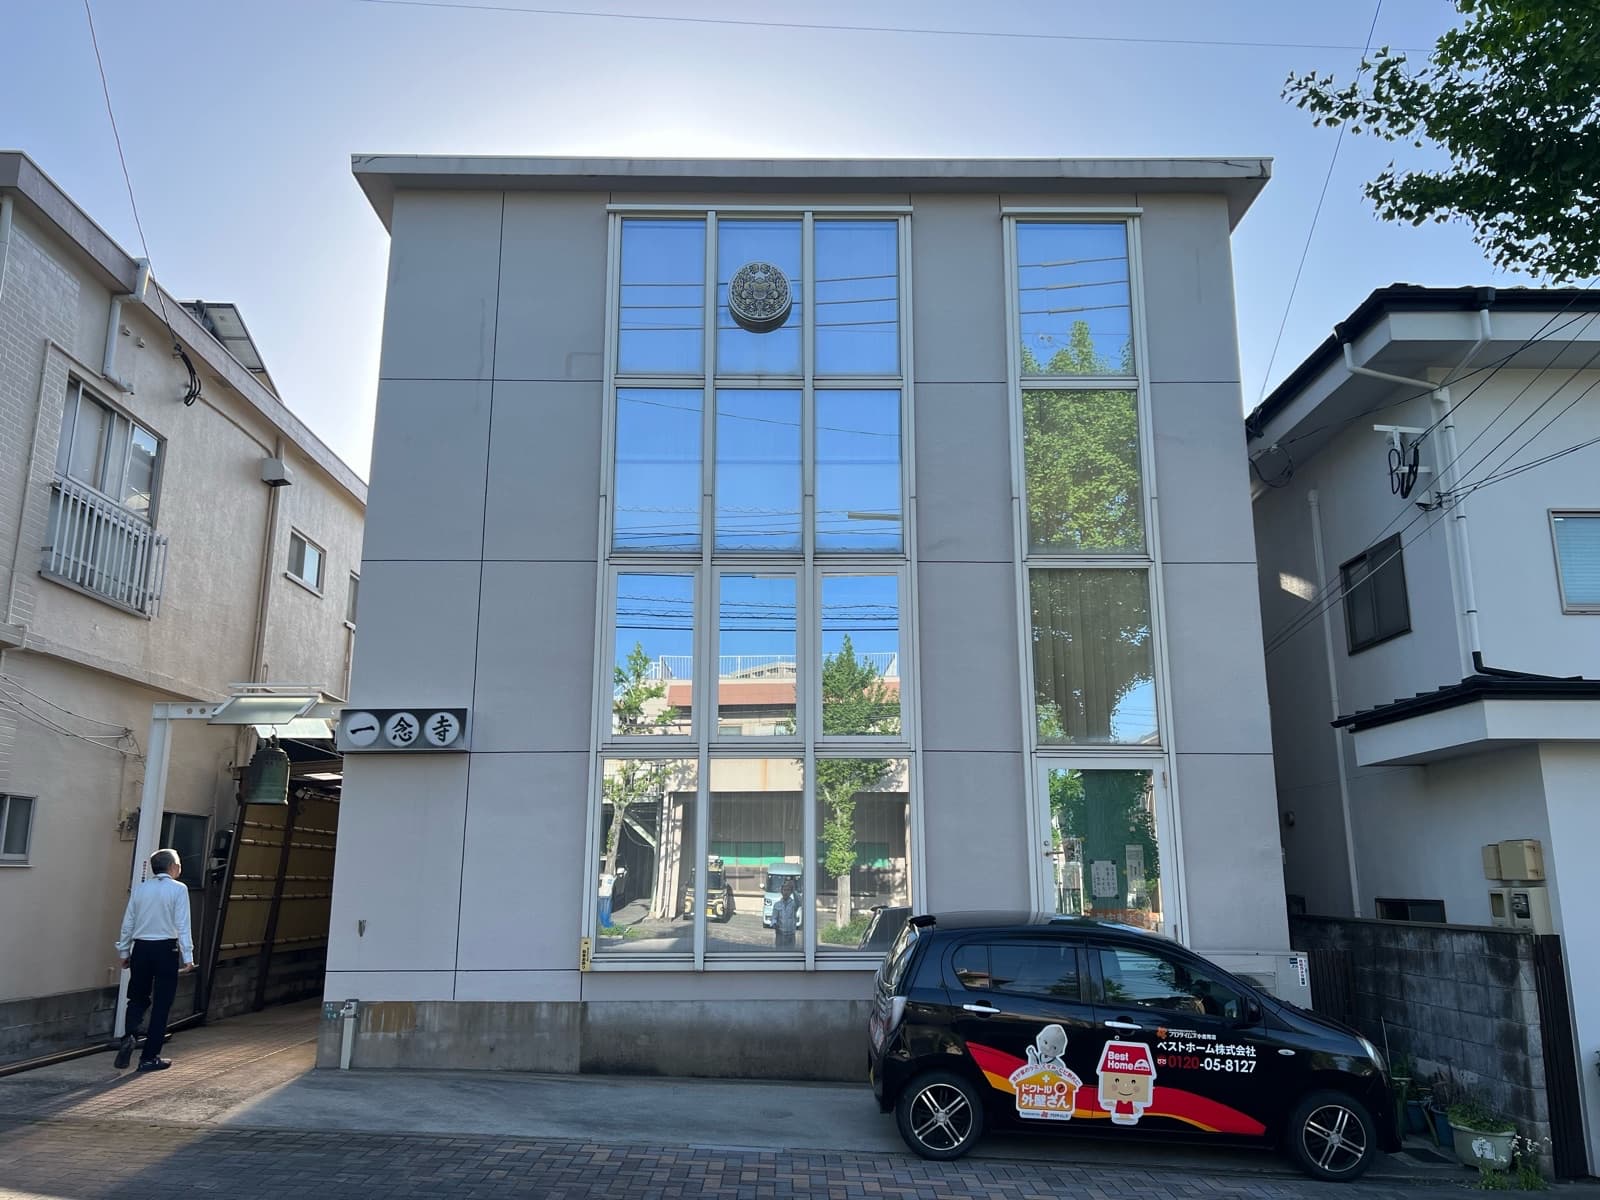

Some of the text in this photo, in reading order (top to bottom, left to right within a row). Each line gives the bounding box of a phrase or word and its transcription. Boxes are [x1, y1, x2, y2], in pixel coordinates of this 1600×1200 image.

[350, 715, 452, 742] 一念寺
[1107, 1050, 1129, 1061] Best
[1157, 1041, 1257, 1057] ベストホーム株式会社
[1107, 1060, 1134, 1071] Home
[1168, 1055, 1257, 1073] 0120-05-8127
[1021, 1083, 1053, 1094] ドクトル
[1021, 1094, 1070, 1109] 外壁さん
